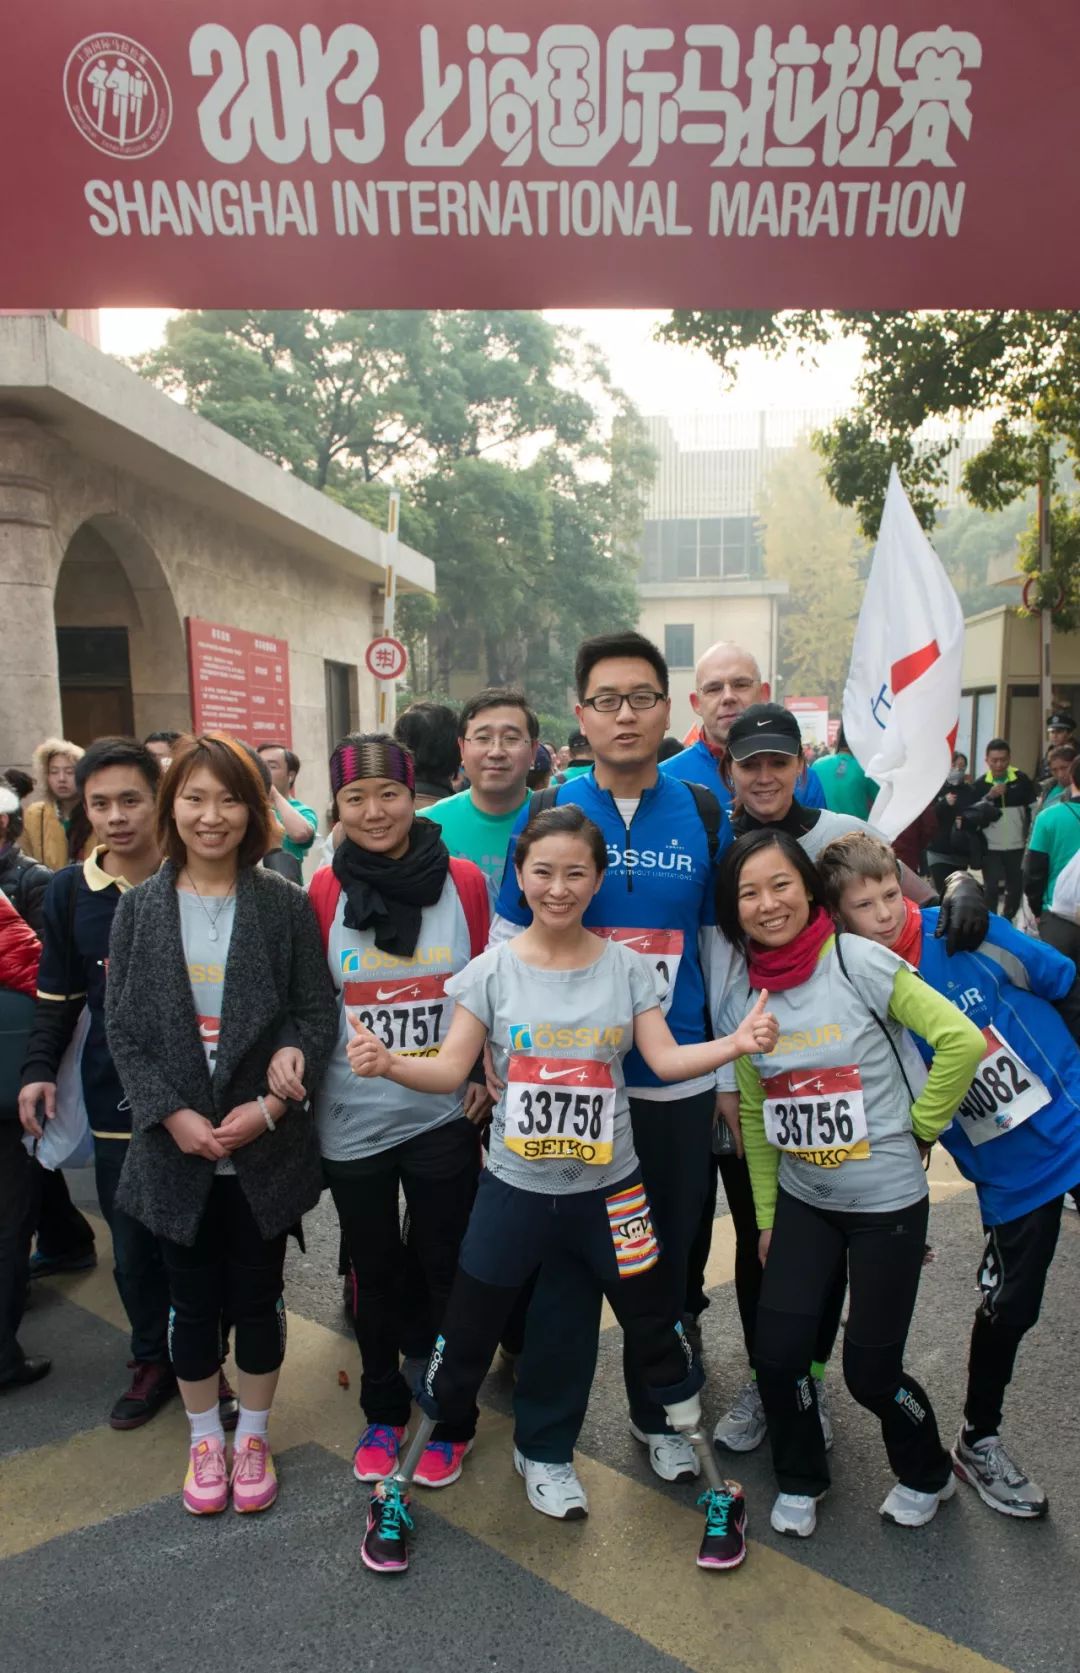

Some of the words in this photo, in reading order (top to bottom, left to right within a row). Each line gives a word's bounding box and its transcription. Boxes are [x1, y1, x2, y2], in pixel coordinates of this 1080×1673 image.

[189, 23, 385, 165] 2013
[405, 23, 983, 167] 上海国际马拉松赛
[84, 180, 318, 236] SHANGHAI
[331, 180, 692, 237] INTERNATIONAL
[708, 181, 965, 237] MARATHON
[518, 1090, 603, 1139] 33758
[775, 1099, 853, 1146] 33756
[524, 1139, 596, 1161] SEIKO
